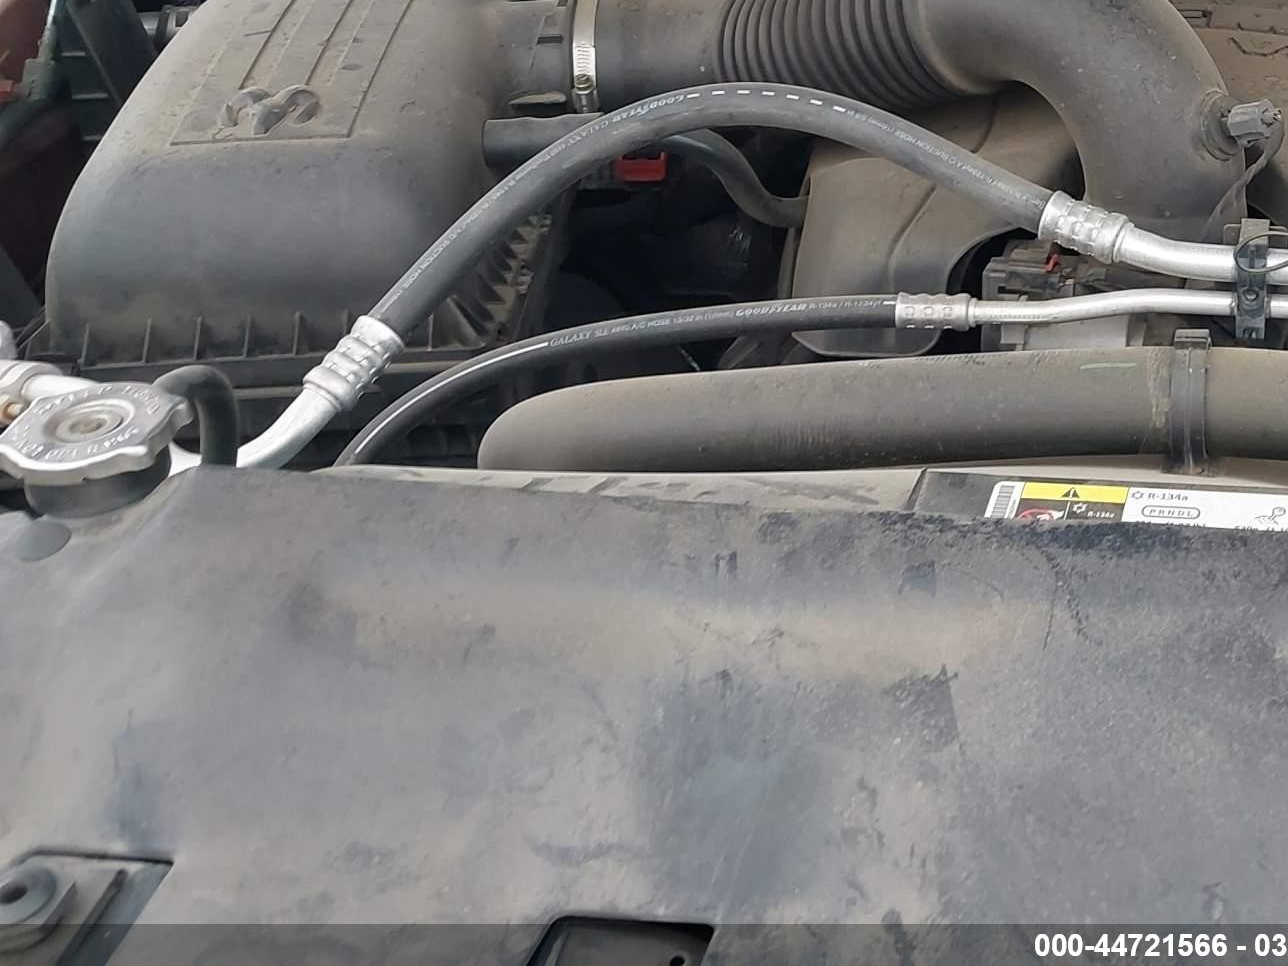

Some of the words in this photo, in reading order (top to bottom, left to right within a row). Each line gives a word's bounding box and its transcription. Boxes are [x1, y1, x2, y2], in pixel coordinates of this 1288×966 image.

[609, 92, 685, 125] GOODYEAR
[550, 331, 592, 347] GALAXY
[647, 317, 671, 327] HOSE
[735, 302, 808, 317] GOODYEAR
[1147, 492, 1190, 502] R-134a
